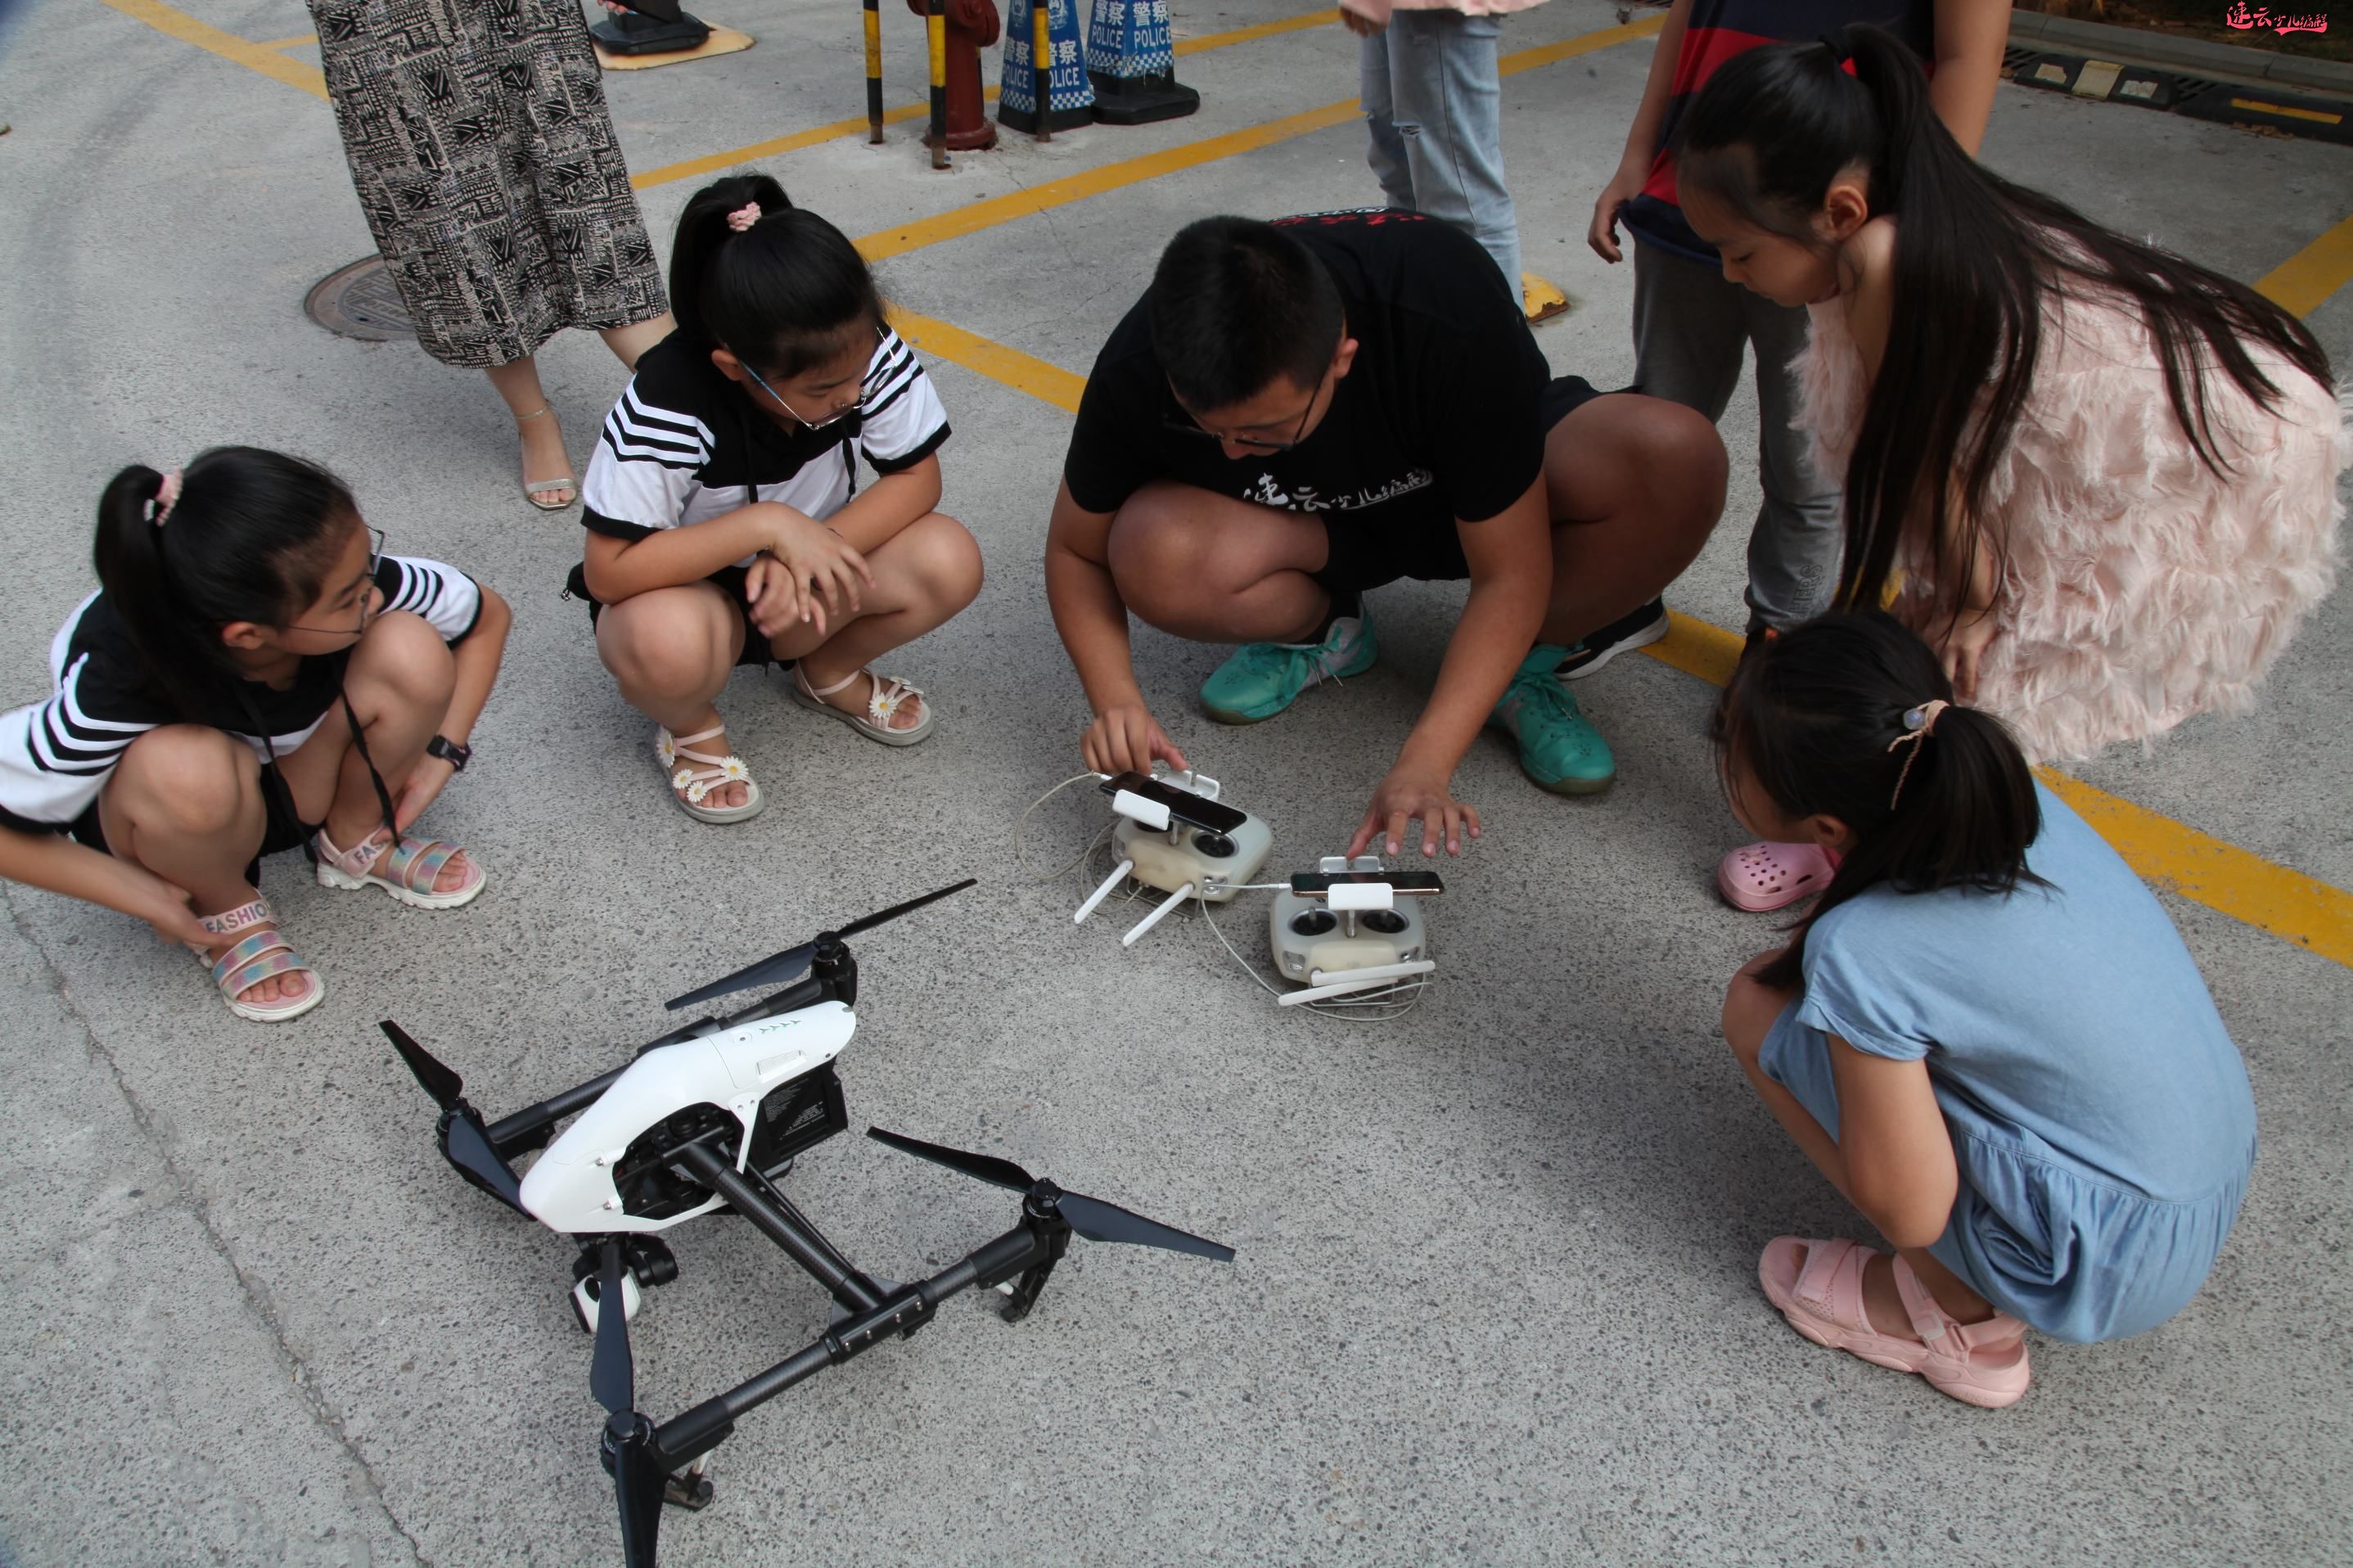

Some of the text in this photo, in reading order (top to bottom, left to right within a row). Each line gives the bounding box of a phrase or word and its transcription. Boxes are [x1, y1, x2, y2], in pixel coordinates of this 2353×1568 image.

[1095, 0, 1125, 26] 警察
[1133, 0, 1168, 27] 警察
[1091, 25, 1124, 49] POLICE
[1134, 26, 1172, 49] POLICE
[1003, 63, 1029, 88] POLICE
[1048, 67, 1080, 89] OLICE
